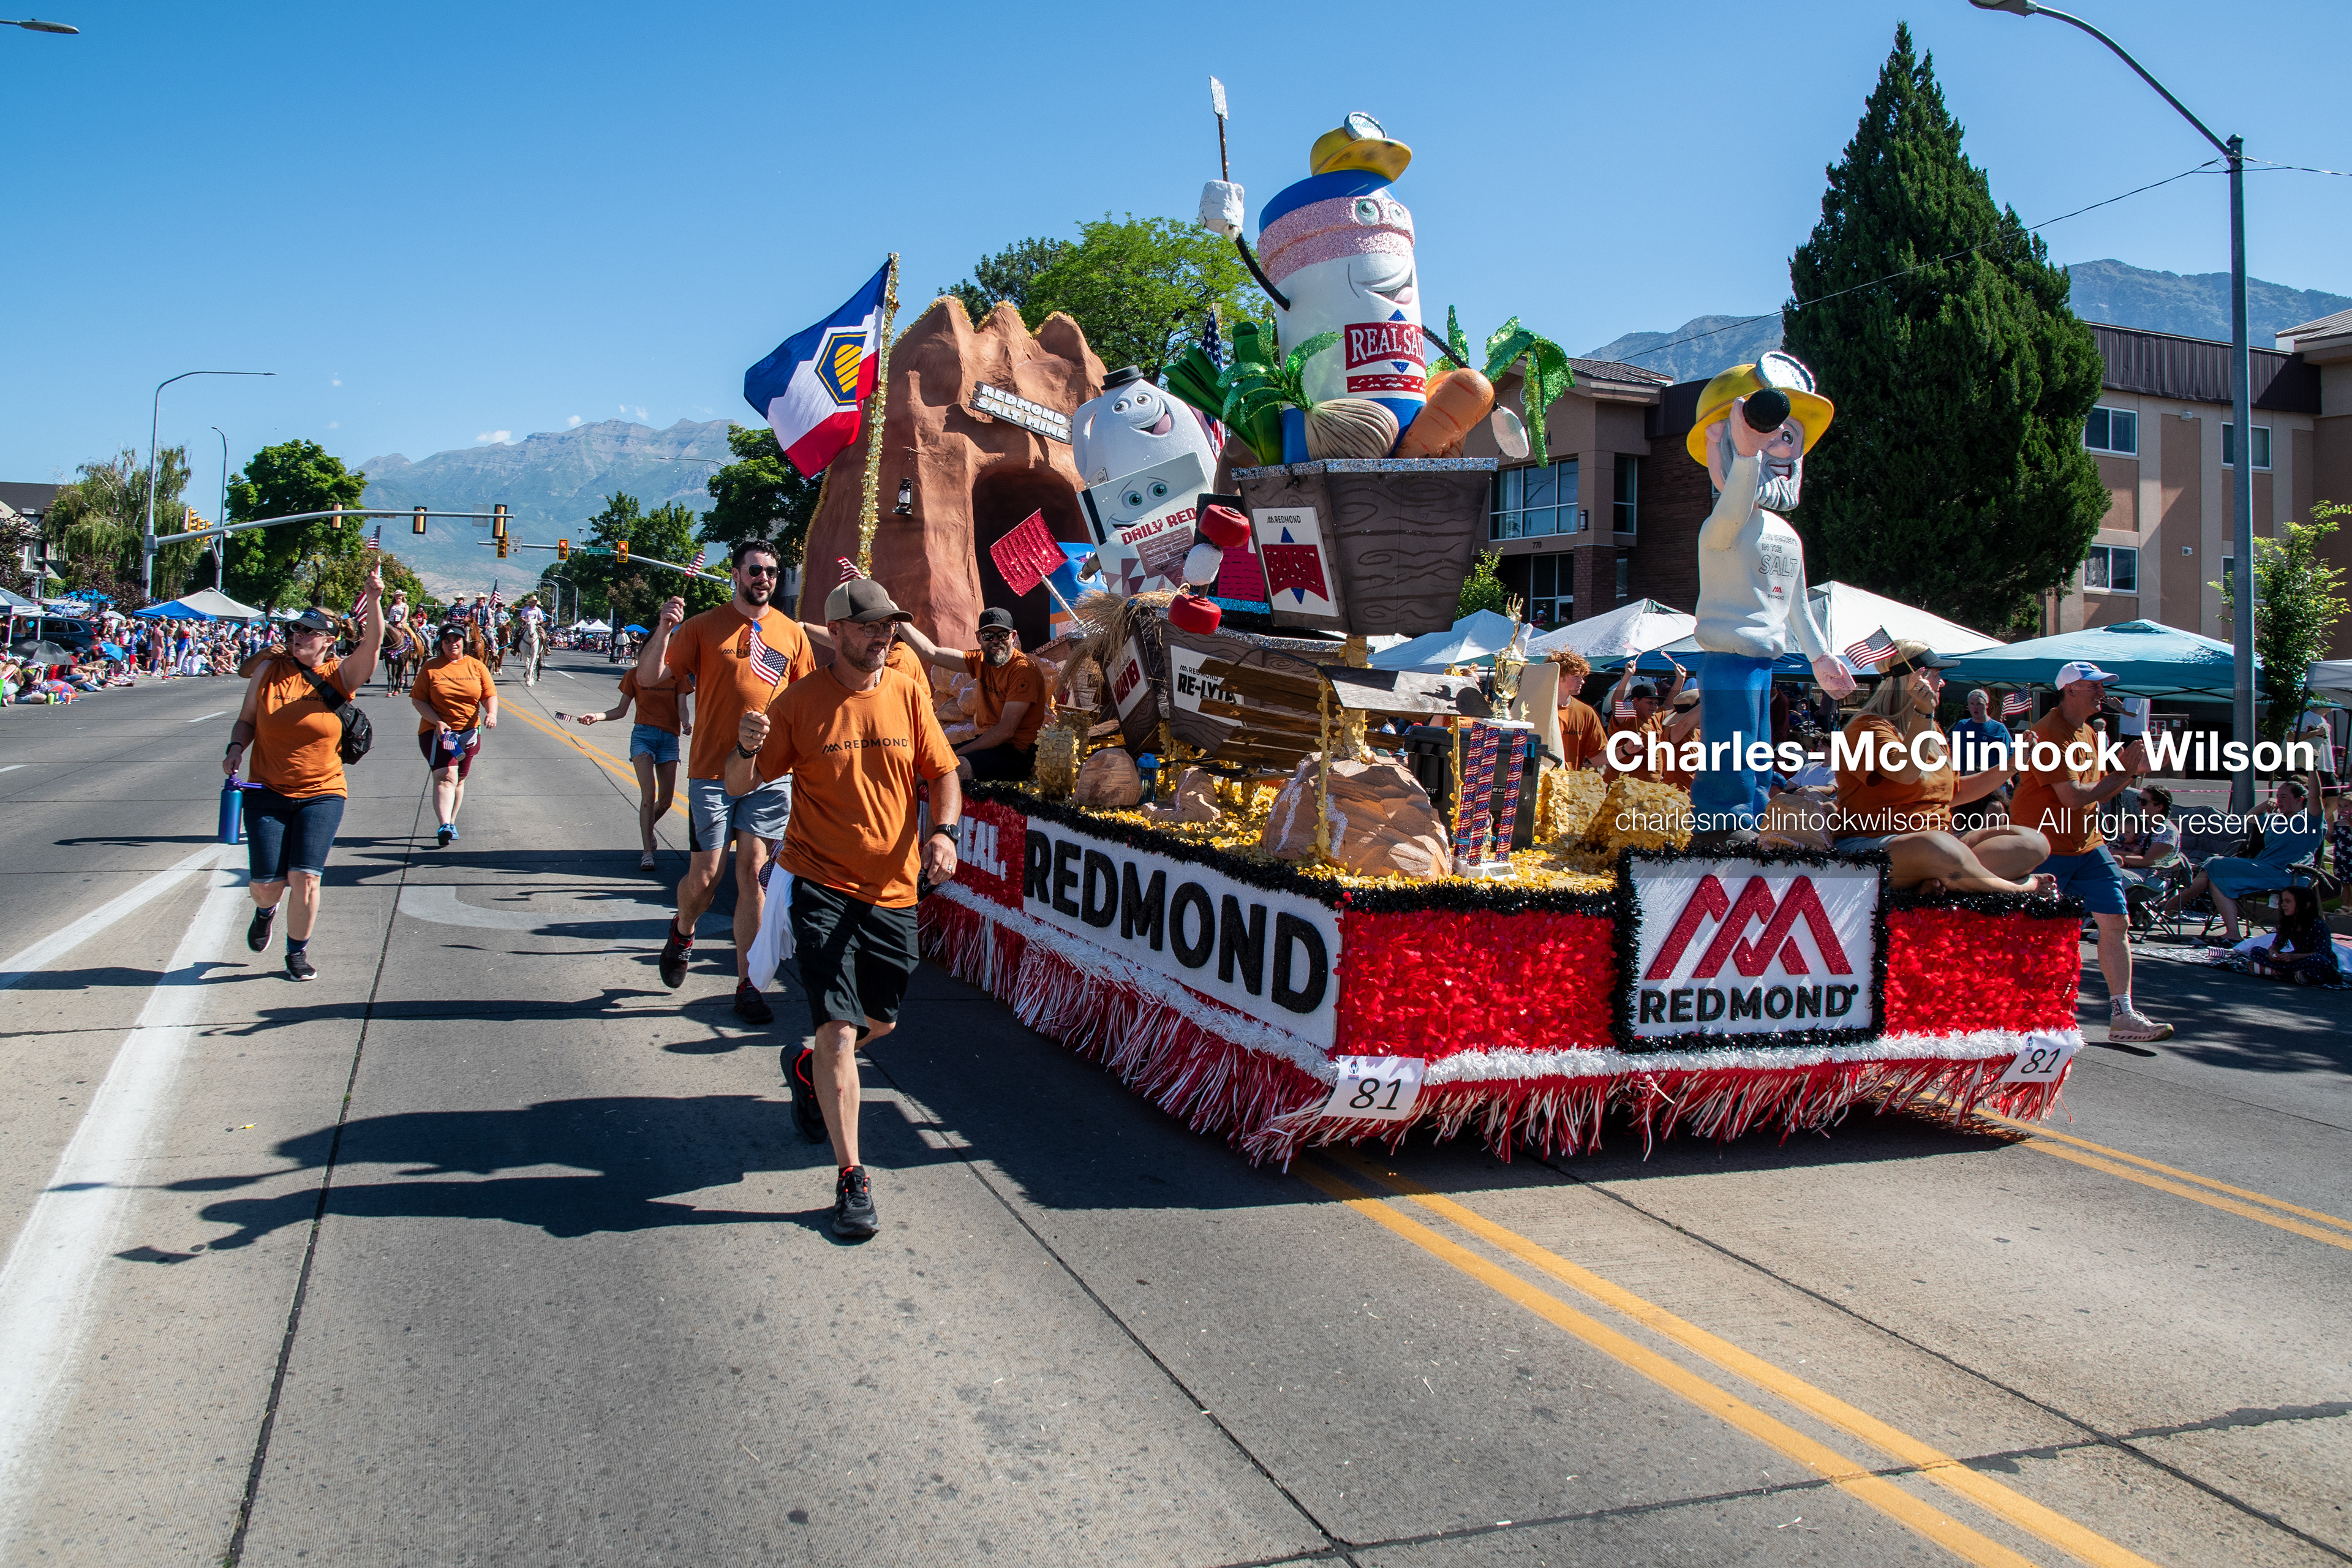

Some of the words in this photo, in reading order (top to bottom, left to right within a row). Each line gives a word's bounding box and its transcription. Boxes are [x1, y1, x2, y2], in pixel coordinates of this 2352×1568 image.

[1350, 328, 1402, 363] REAL
[977, 398, 1021, 421] SALT
[1024, 415, 1068, 440] MINE
[981, 384, 1066, 424] REDMOND
[1121, 518, 1163, 546] DAILY
[1165, 507, 1197, 528] RED
[1275, 515, 1302, 524] REDMOND
[1758, 554, 1798, 578] SALT
[1770, 544, 1783, 554] THE
[844, 737, 908, 750] REDMOND
[1022, 829, 1329, 1014] REDMOND
[1638, 984, 1853, 1025] REDMOND
[2020, 1047, 2061, 1074] 81
[1349, 1077, 1402, 1110] 81
